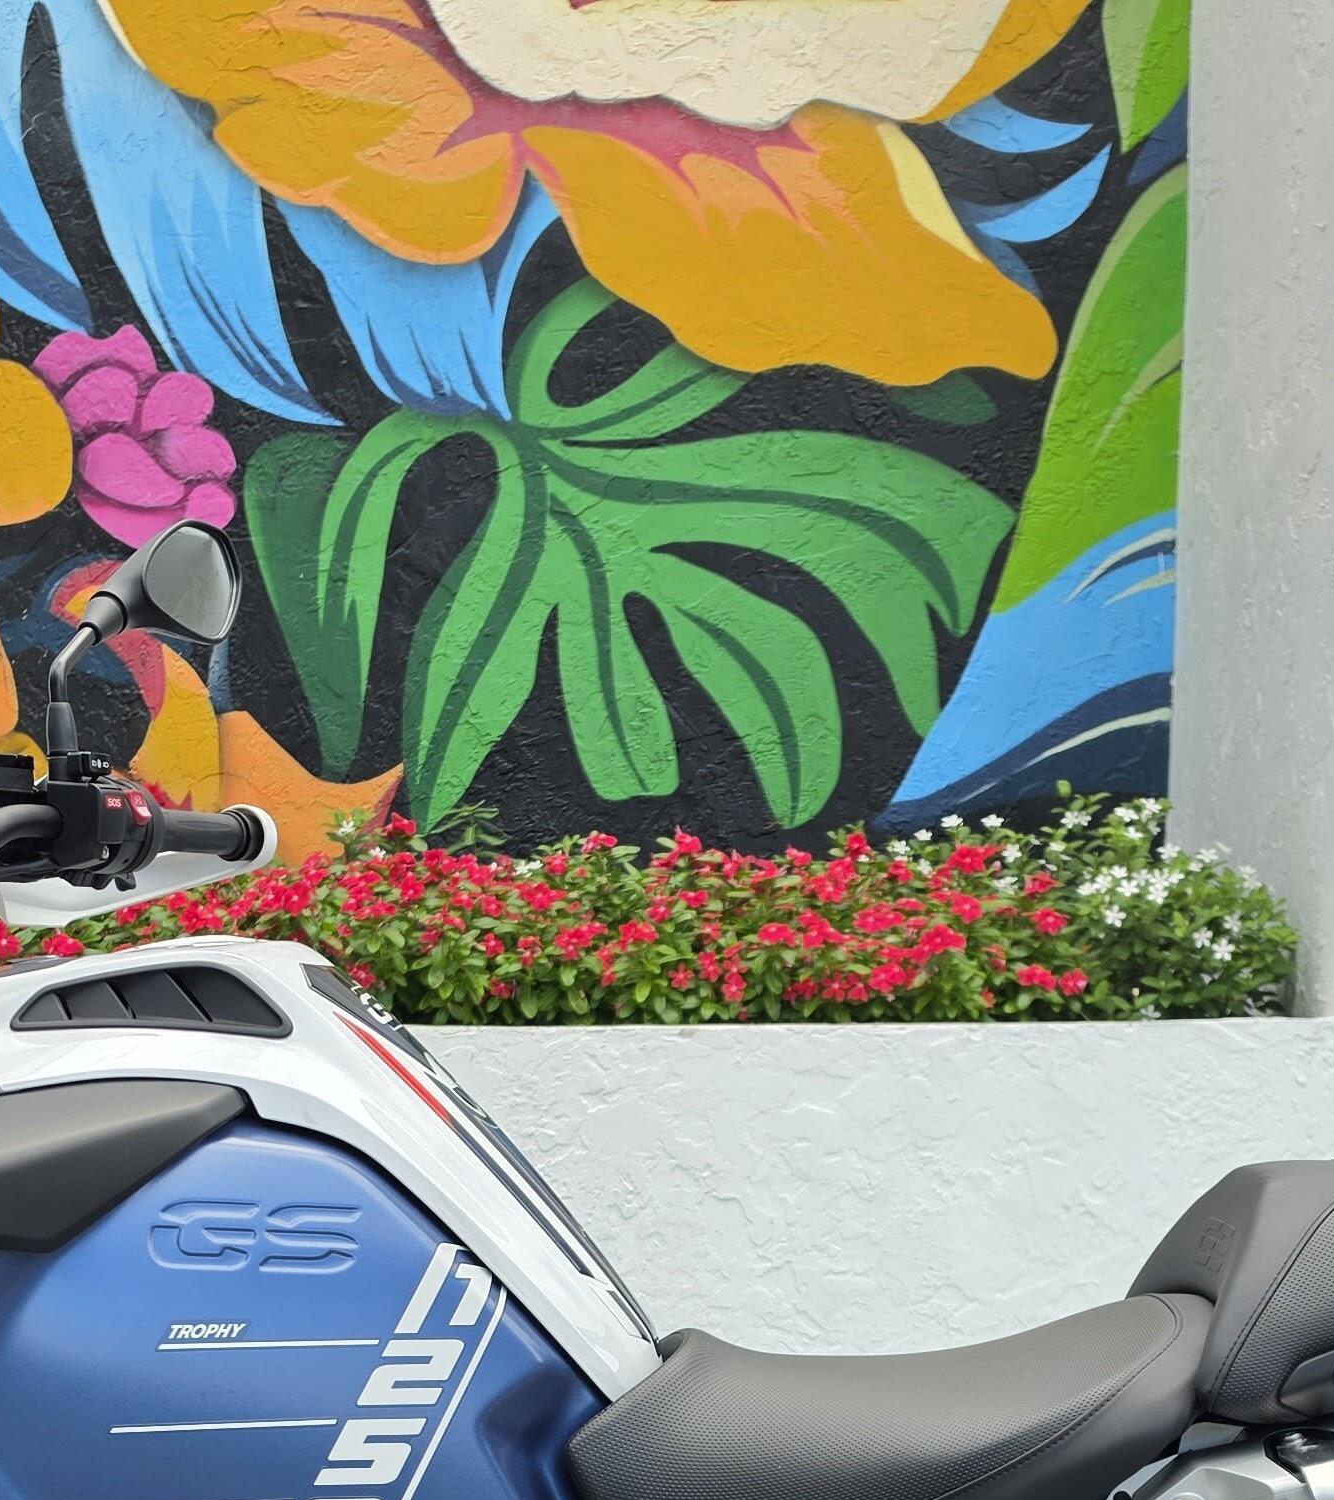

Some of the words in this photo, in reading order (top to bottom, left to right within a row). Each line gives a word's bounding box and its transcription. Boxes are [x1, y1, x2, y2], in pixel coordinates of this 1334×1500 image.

[107, 797, 122, 808] SOS
[147, 1199, 362, 1275] GS
[167, 1321, 248, 1341] TROPHY
